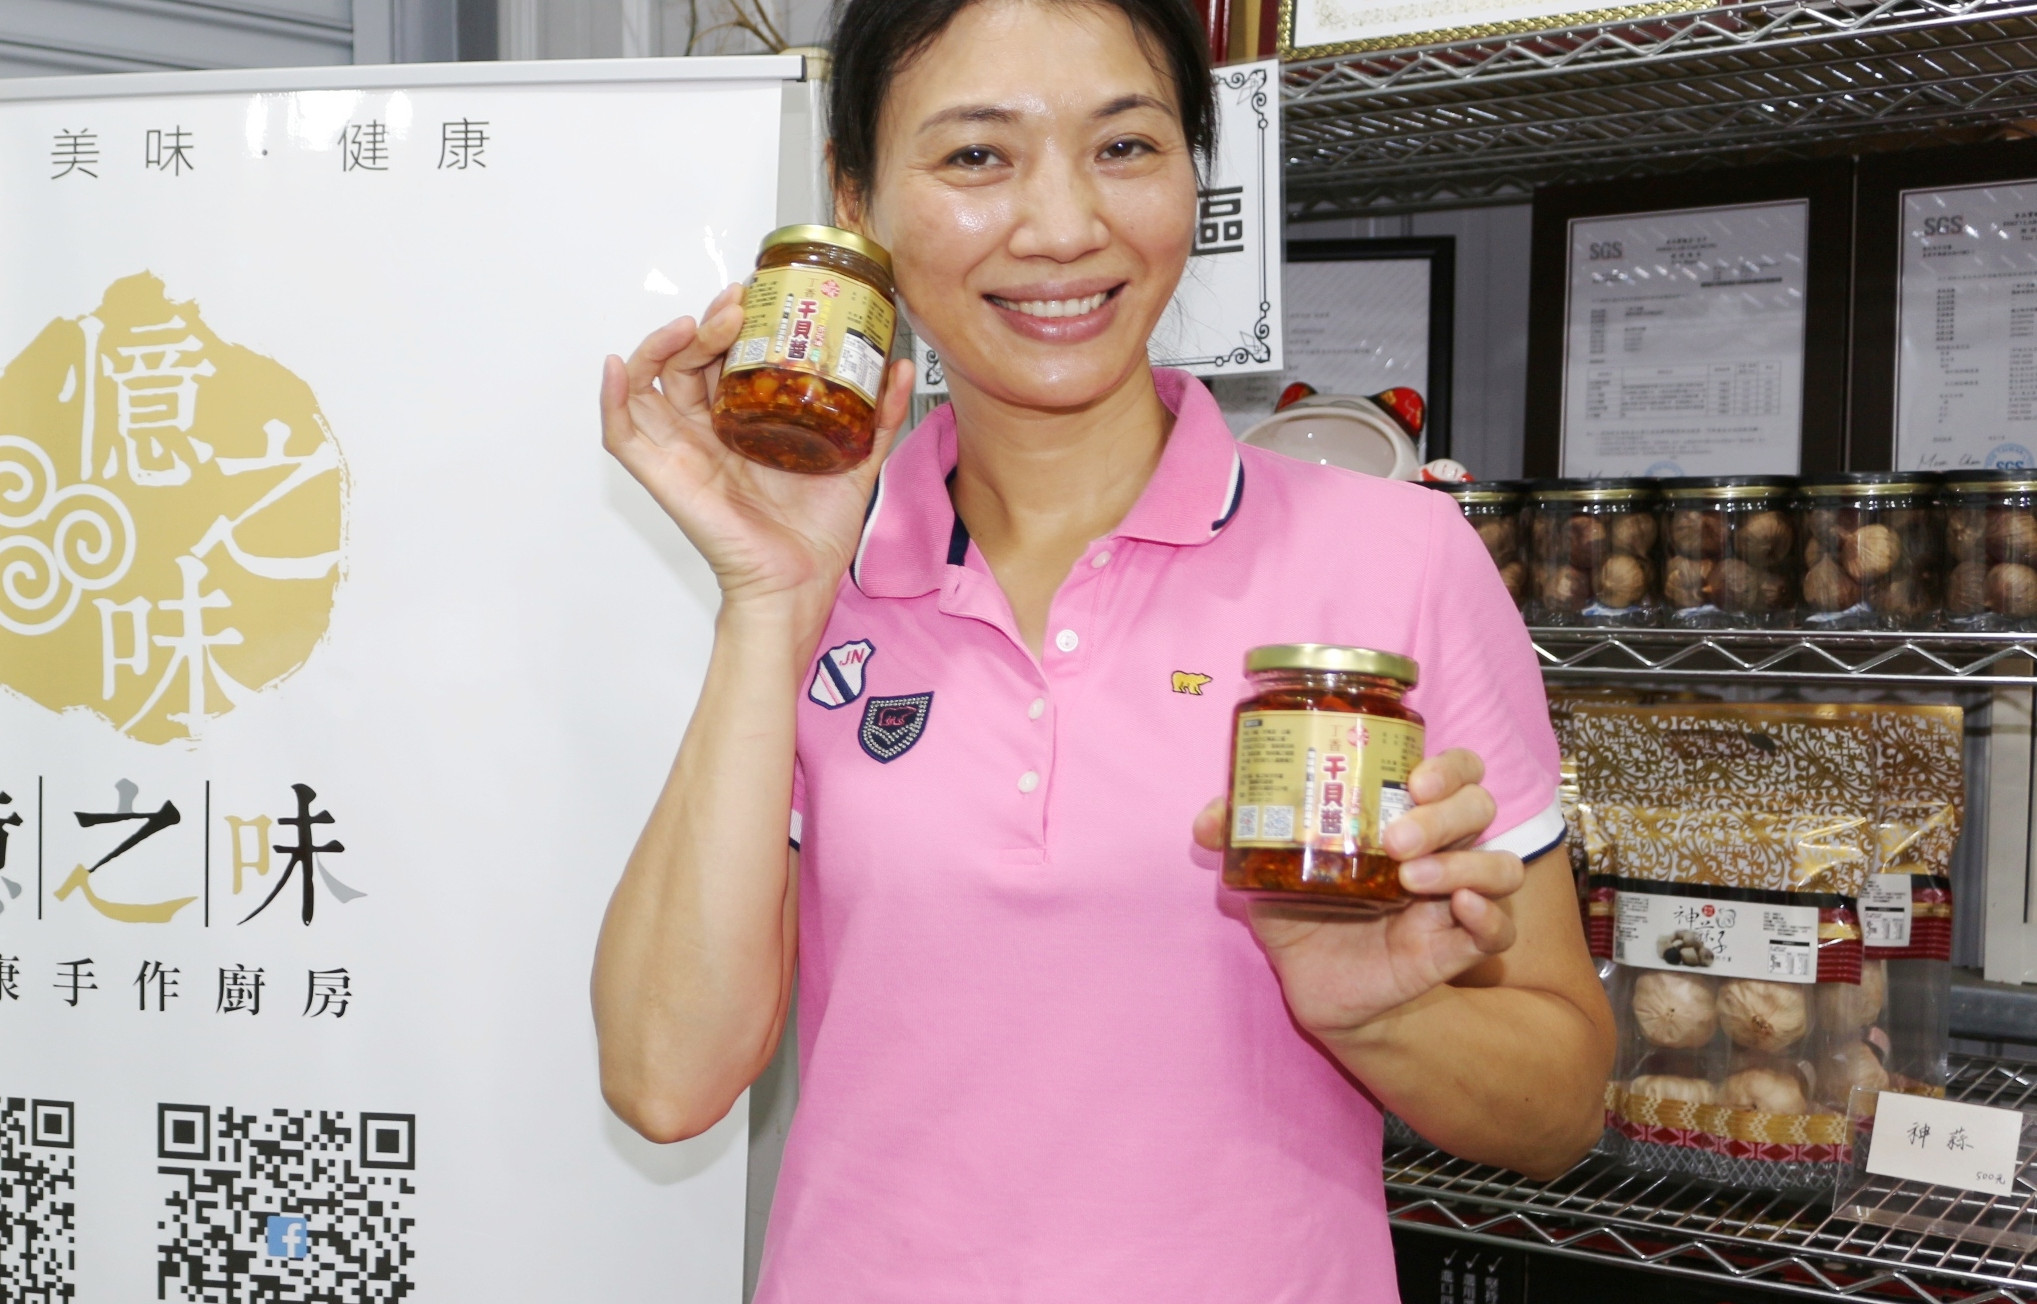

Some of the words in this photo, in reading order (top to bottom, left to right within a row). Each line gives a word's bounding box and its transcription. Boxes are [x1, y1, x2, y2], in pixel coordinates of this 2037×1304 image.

[1924, 214, 1963, 236] SGS
[1589, 241, 1623, 261] SGS
[839, 647, 865, 666] JN
